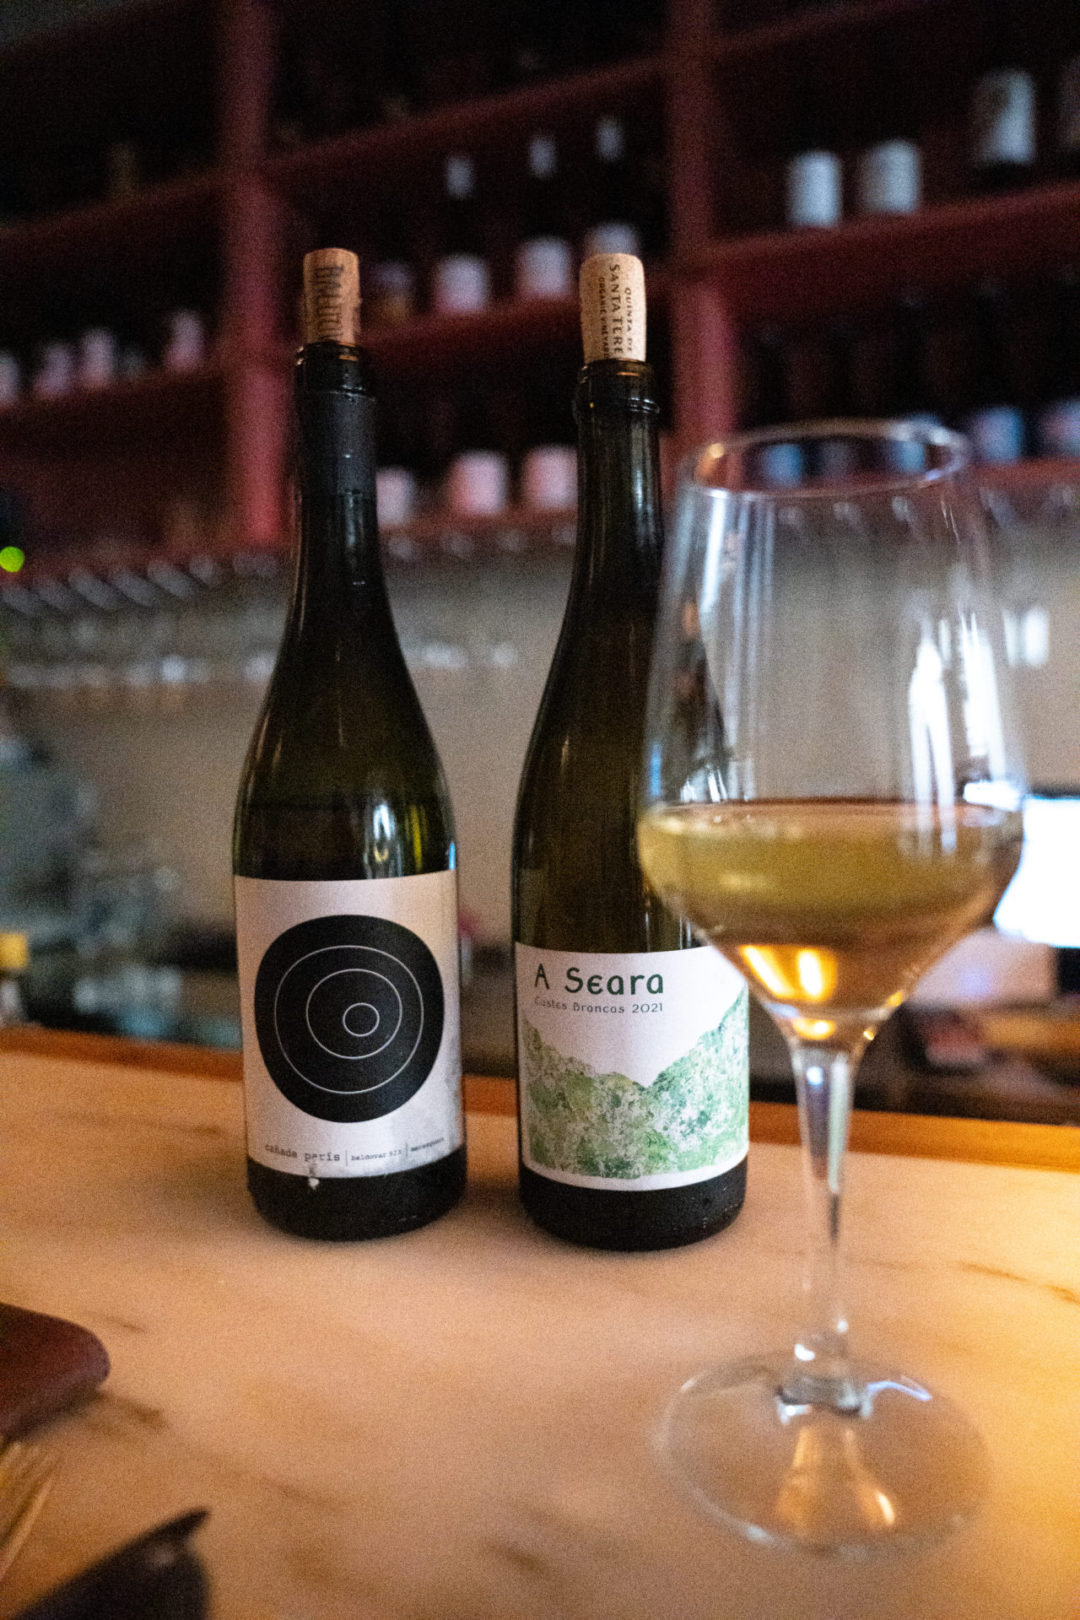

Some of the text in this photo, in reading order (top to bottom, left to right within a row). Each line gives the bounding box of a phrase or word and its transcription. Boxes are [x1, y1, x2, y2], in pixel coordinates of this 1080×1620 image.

[610, 264, 621, 312] SANTA
[534, 963, 664, 995] A Seara
[573, 1002, 625, 1014] Brancas
[632, 1003, 663, 1013] 2021
